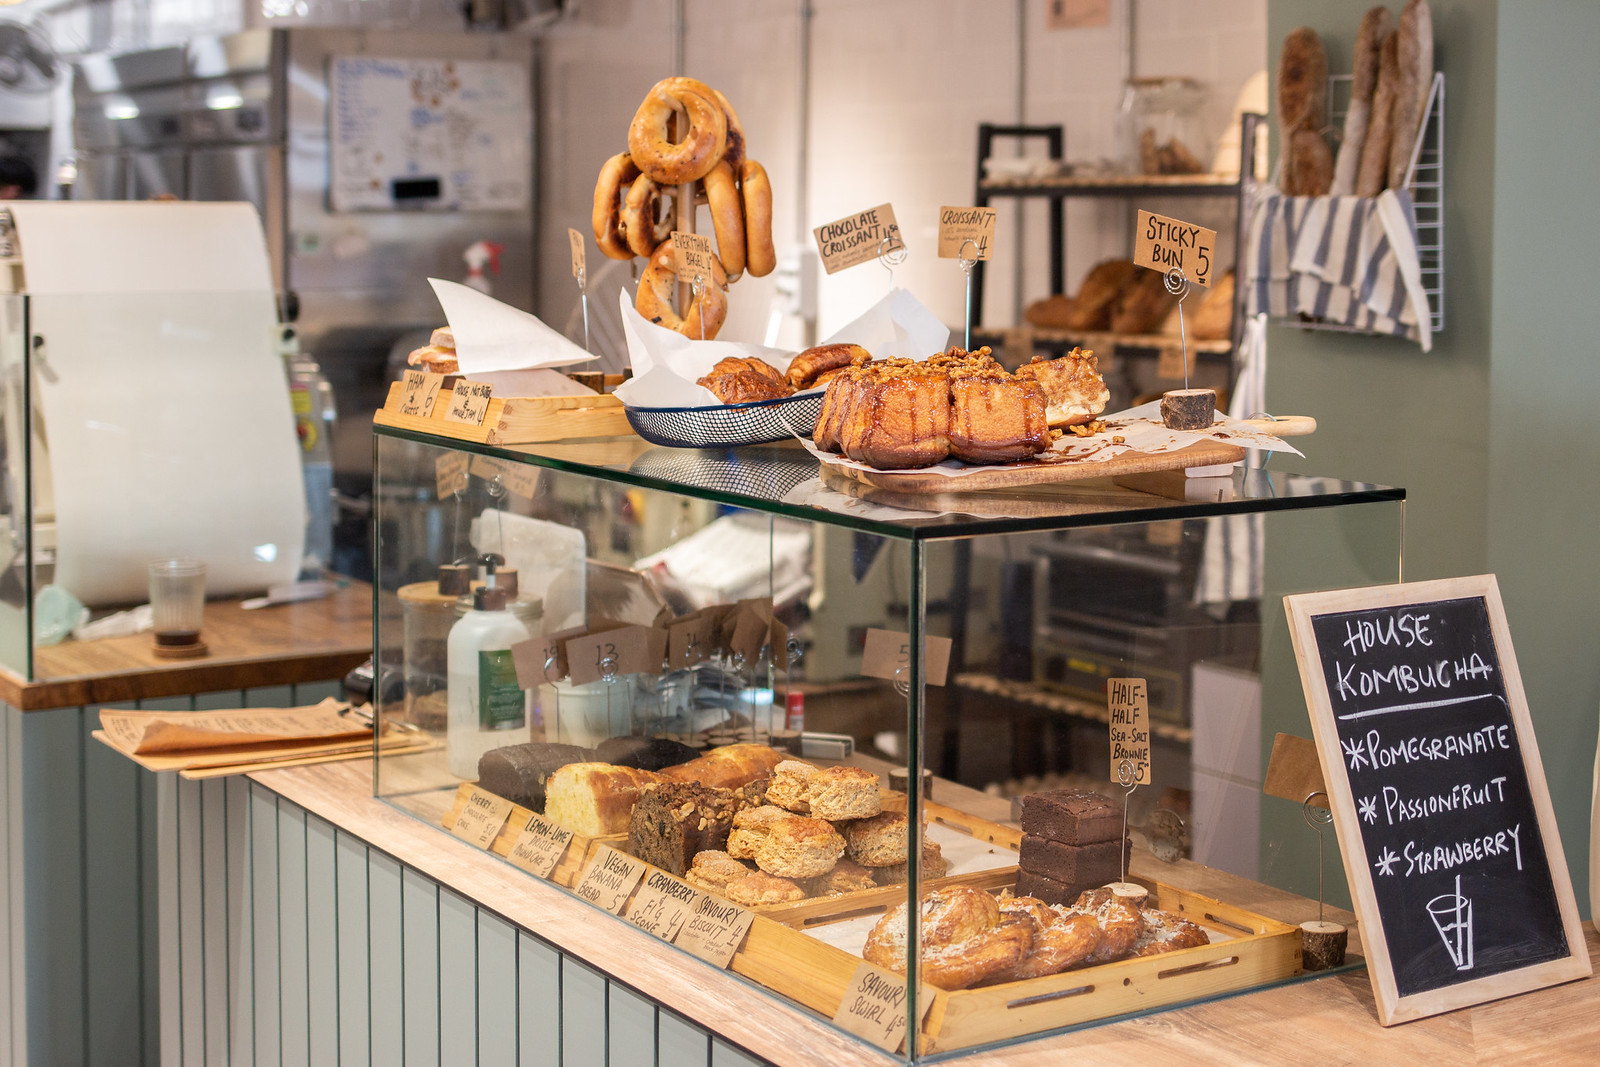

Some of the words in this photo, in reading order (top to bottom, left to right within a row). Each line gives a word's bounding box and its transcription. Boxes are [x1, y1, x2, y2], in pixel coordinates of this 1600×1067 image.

[821, 210, 878, 244] CHOCOLATE
[942, 210, 996, 228] CROISSANT
[1147, 216, 1200, 249] STICKY
[674, 232, 709, 253] EVERYTHING
[822, 224, 881, 257] CROISSANT
[686, 251, 705, 269] BAGEL
[1152, 243, 1183, 268] BUN
[1196, 246, 1209, 276] 5
[406, 373, 425, 392] HAM
[1343, 614, 1433, 656] HOUSE
[595, 643, 619, 666] 13
[1336, 653, 1493, 701] KOMBUCHA
[1111, 681, 1145, 706] HALF-
[1111, 708, 1140, 725] HALF
[1113, 743, 1148, 760] BROWNIE
[1366, 724, 1510, 770] POMEGRANATE
[470, 792, 492, 810] CHERRY
[1383, 776, 1507, 825] PASSIONFRUIT
[524, 815, 570, 844] LEMON-LIME
[528, 835, 555, 852] DRIZZLE
[1403, 823, 1523, 877] STRAWBERRY
[587, 864, 623, 891] BANANA
[603, 850, 635, 880] VEGAN
[577, 880, 601, 901] BREAD
[647, 871, 698, 905] CRANBERRY
[630, 910, 660, 933] SCONE
[642, 898, 665, 922] FIG
[695, 895, 745, 928] SAVOURY
[688, 915, 727, 940] BISCUIT
[849, 995, 886, 1025] SWIRL
